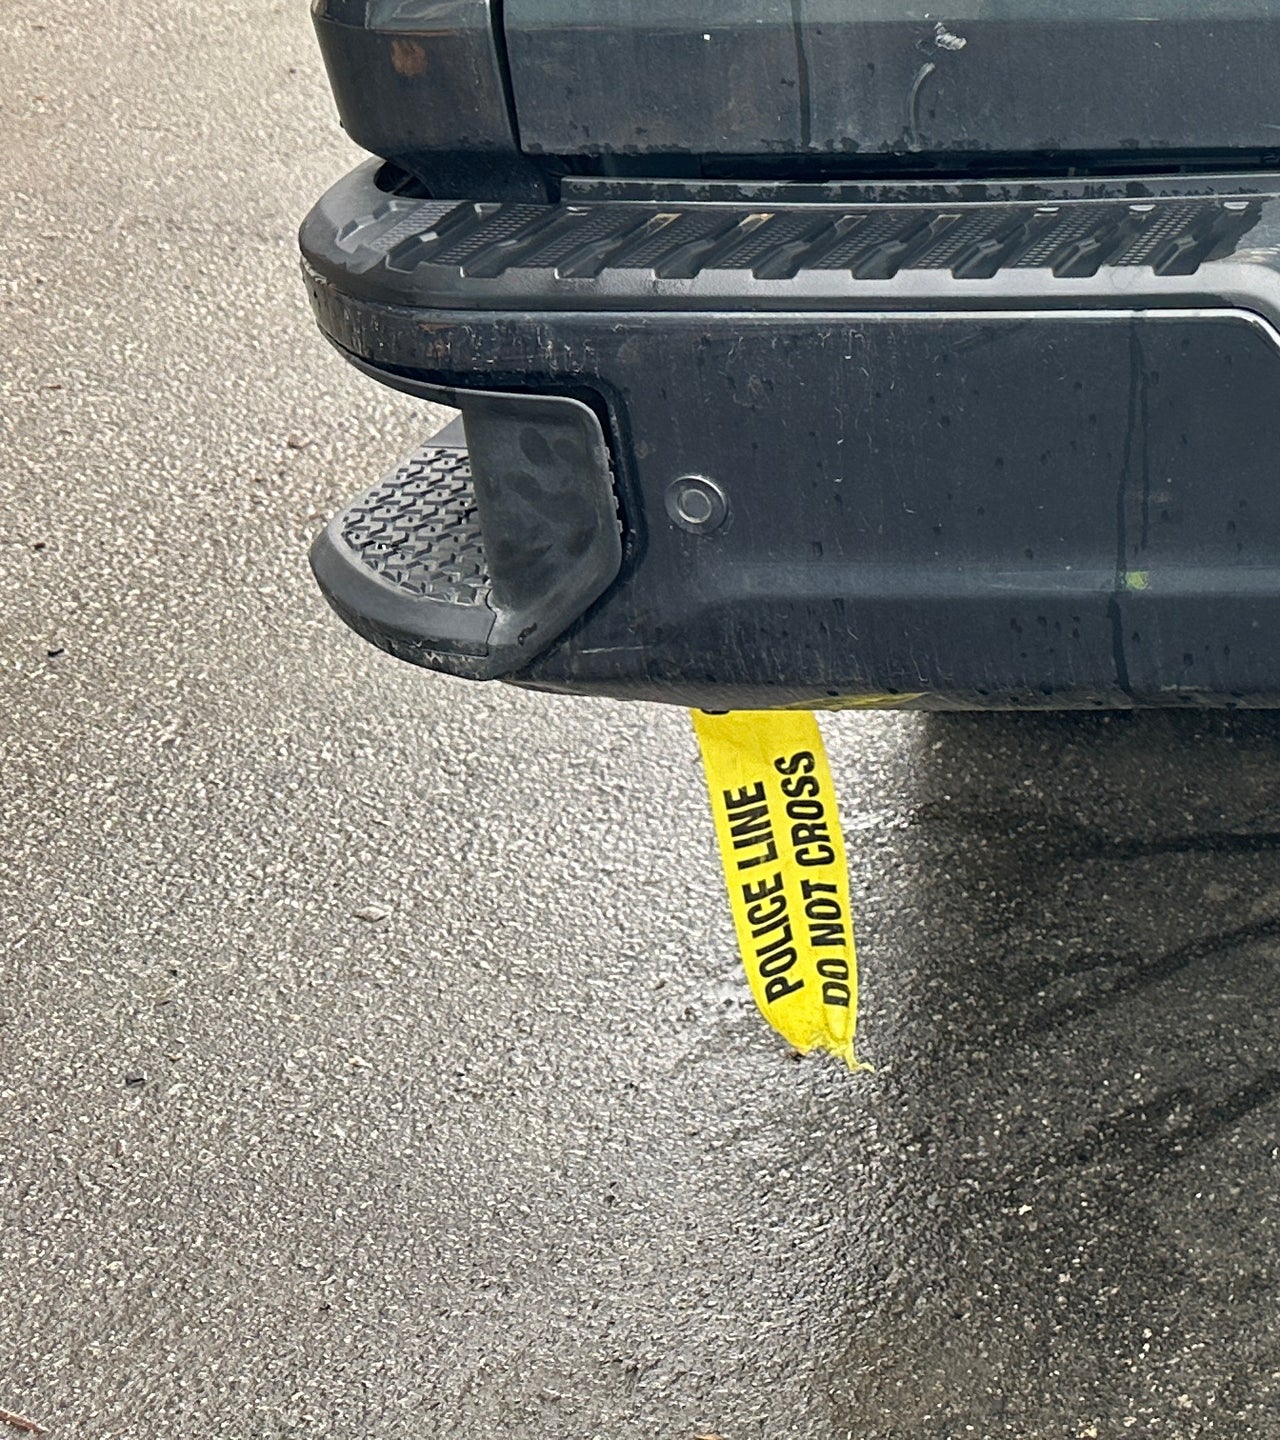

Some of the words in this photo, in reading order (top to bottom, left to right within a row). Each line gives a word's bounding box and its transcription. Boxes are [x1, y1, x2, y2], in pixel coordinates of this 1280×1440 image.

[723, 780, 780, 872] LINE
[774, 750, 835, 867] CROSS
[742, 871, 805, 1005] POLICE
[800, 878, 847, 948] NOT
[817, 958, 851, 1008] DO
